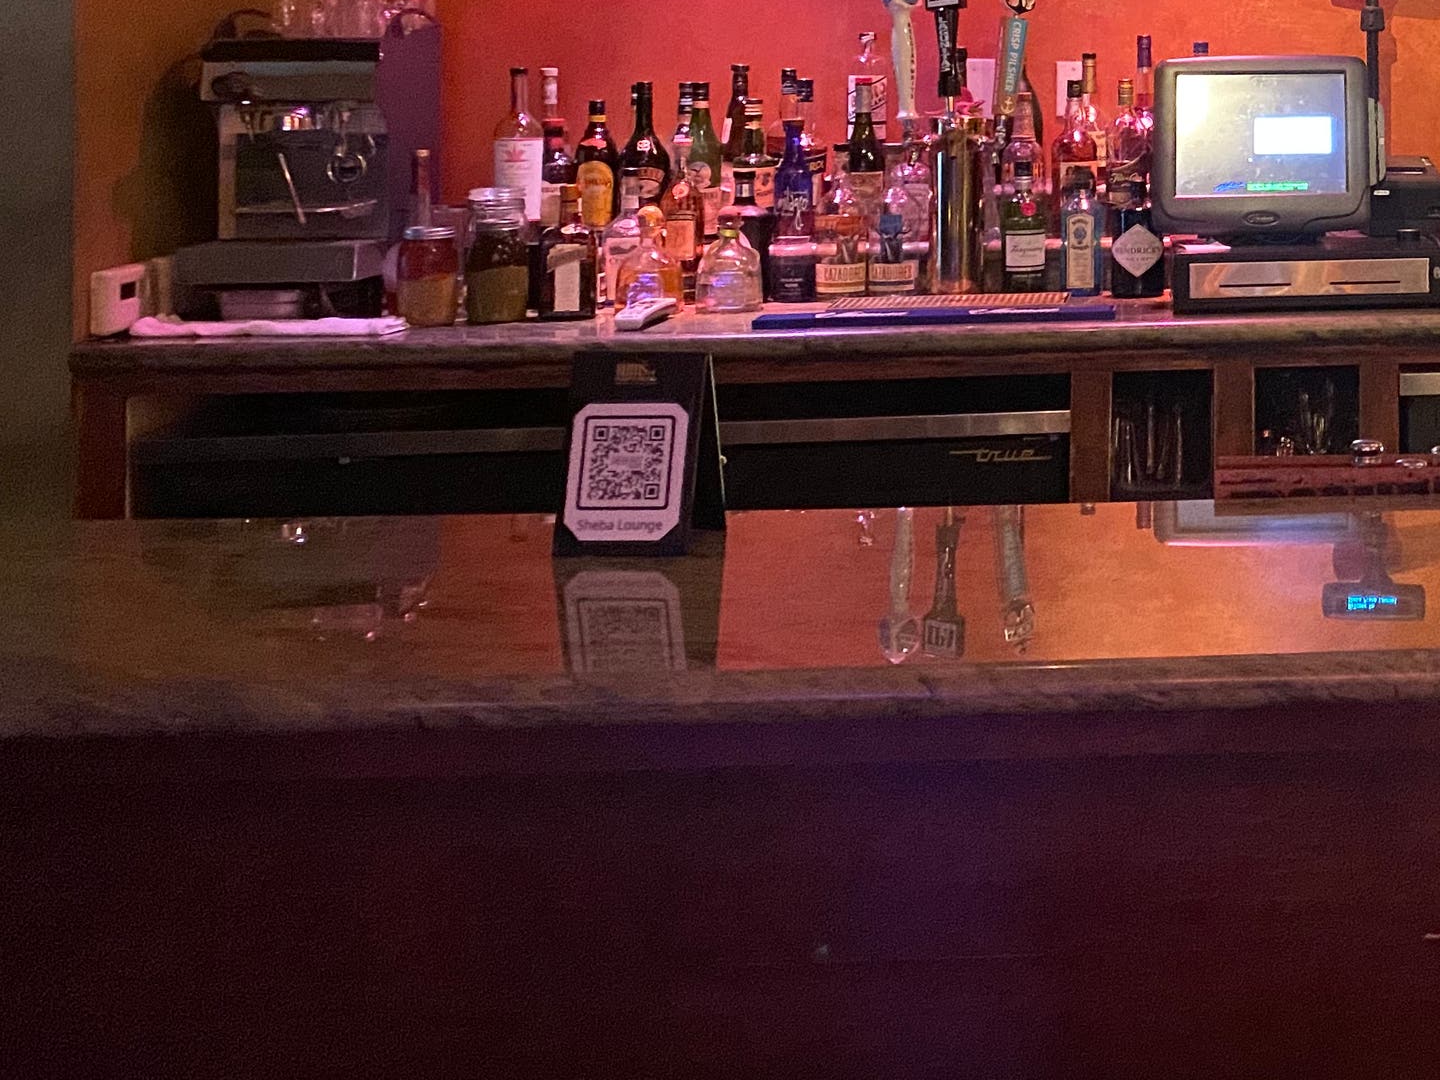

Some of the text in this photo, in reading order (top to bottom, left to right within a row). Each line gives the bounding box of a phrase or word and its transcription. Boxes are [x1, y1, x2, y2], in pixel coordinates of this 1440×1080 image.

[1004, 22, 1022, 93] CRISP PILSNER
[577, 519, 663, 533] Sheba Lounge
